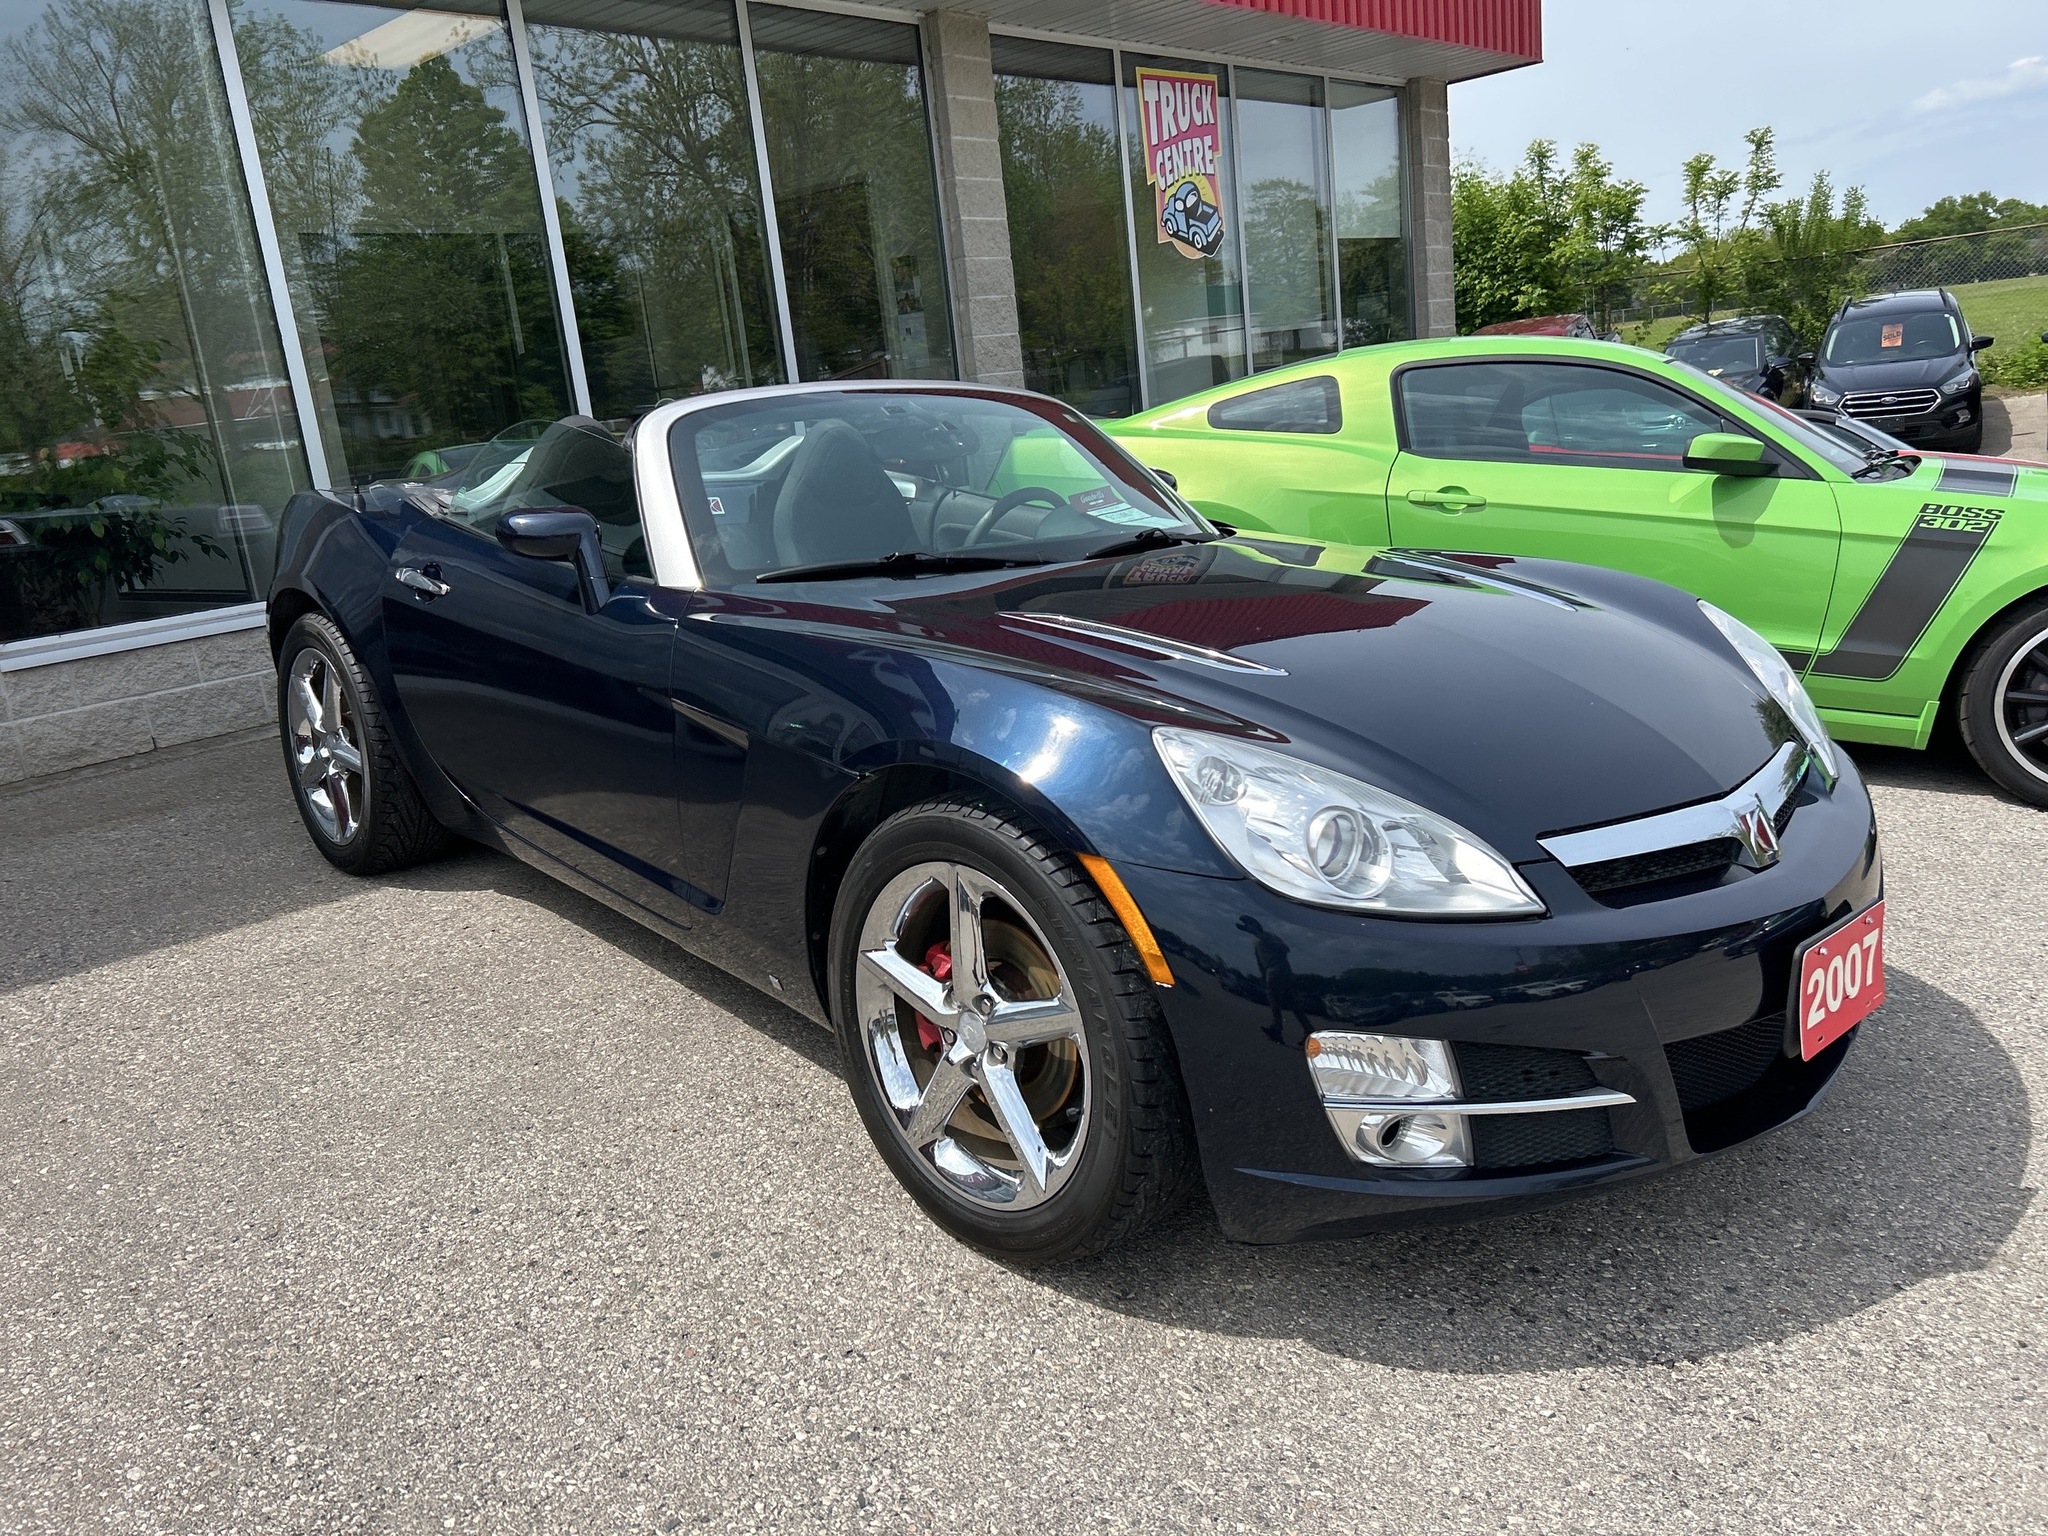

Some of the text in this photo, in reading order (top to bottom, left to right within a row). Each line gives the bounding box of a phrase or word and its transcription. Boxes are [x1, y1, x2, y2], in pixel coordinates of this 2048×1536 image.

[1143, 79, 1215, 146] TRUCK
[1156, 135, 1215, 191] CENTRE
[1882, 330, 1902, 341] SOLD
[1919, 503, 2005, 520] BOSS
[1919, 516, 1989, 533] 302
[1806, 927, 1880, 1031] 2007
